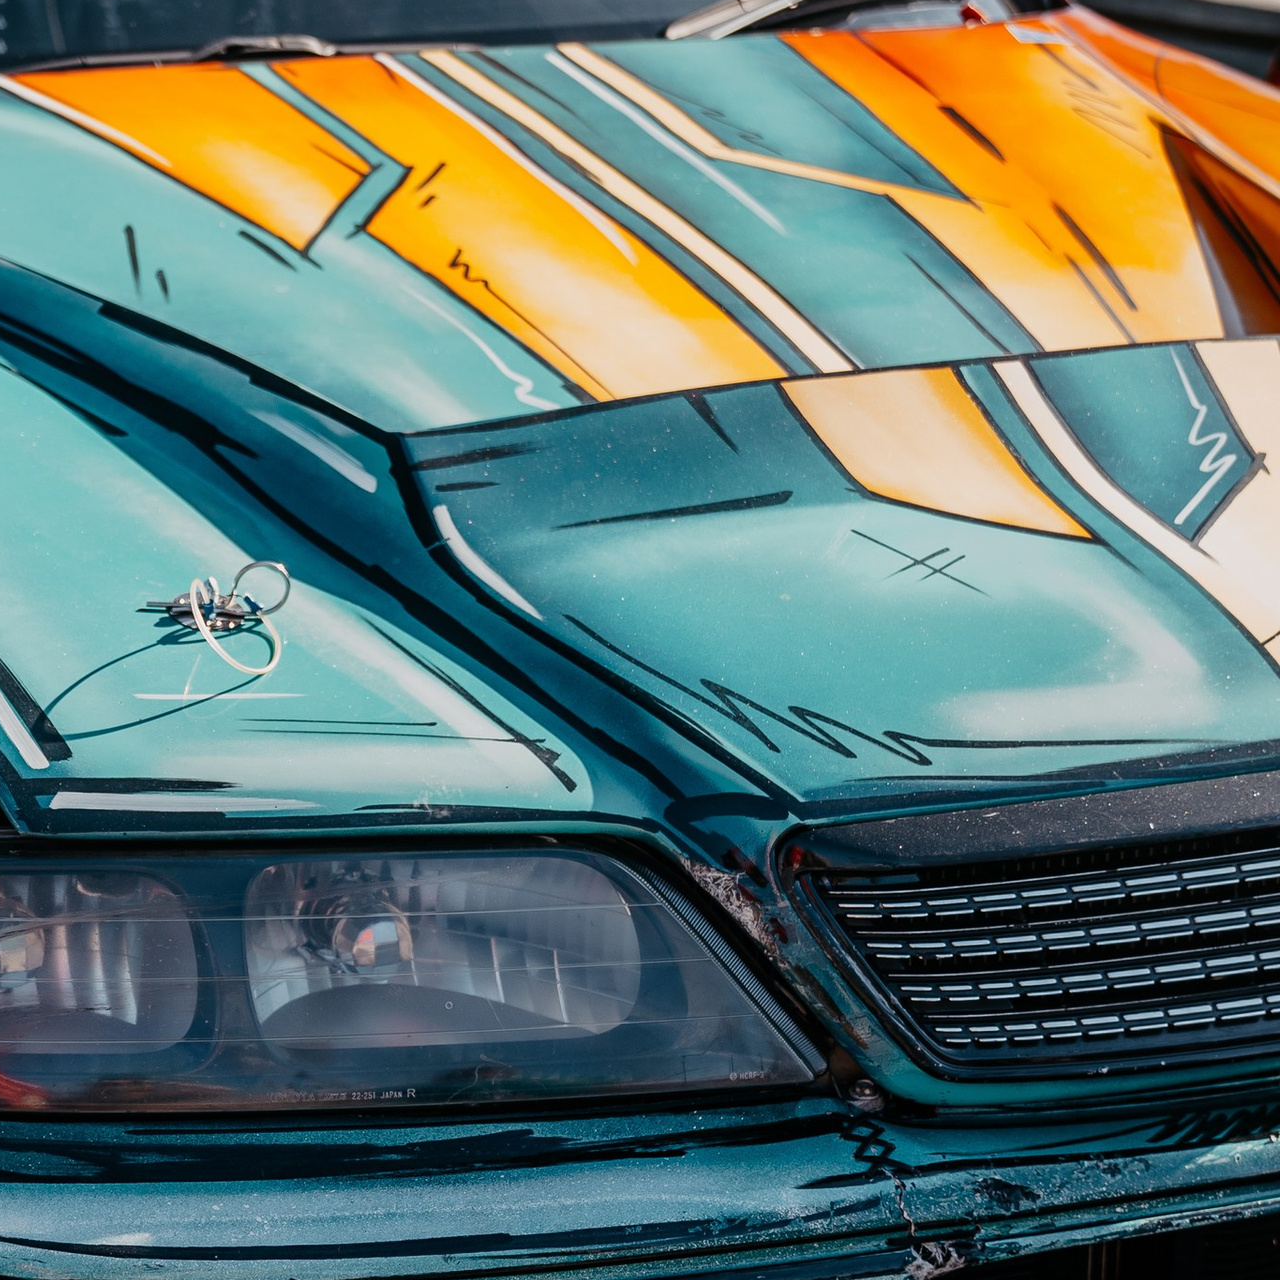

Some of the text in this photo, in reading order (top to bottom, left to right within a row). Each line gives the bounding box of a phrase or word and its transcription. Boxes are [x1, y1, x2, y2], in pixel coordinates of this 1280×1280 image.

[351, 1091, 376, 1101] 22-251
[380, 1090, 403, 1100] JAPAN
[406, 1088, 416, 1098] R
